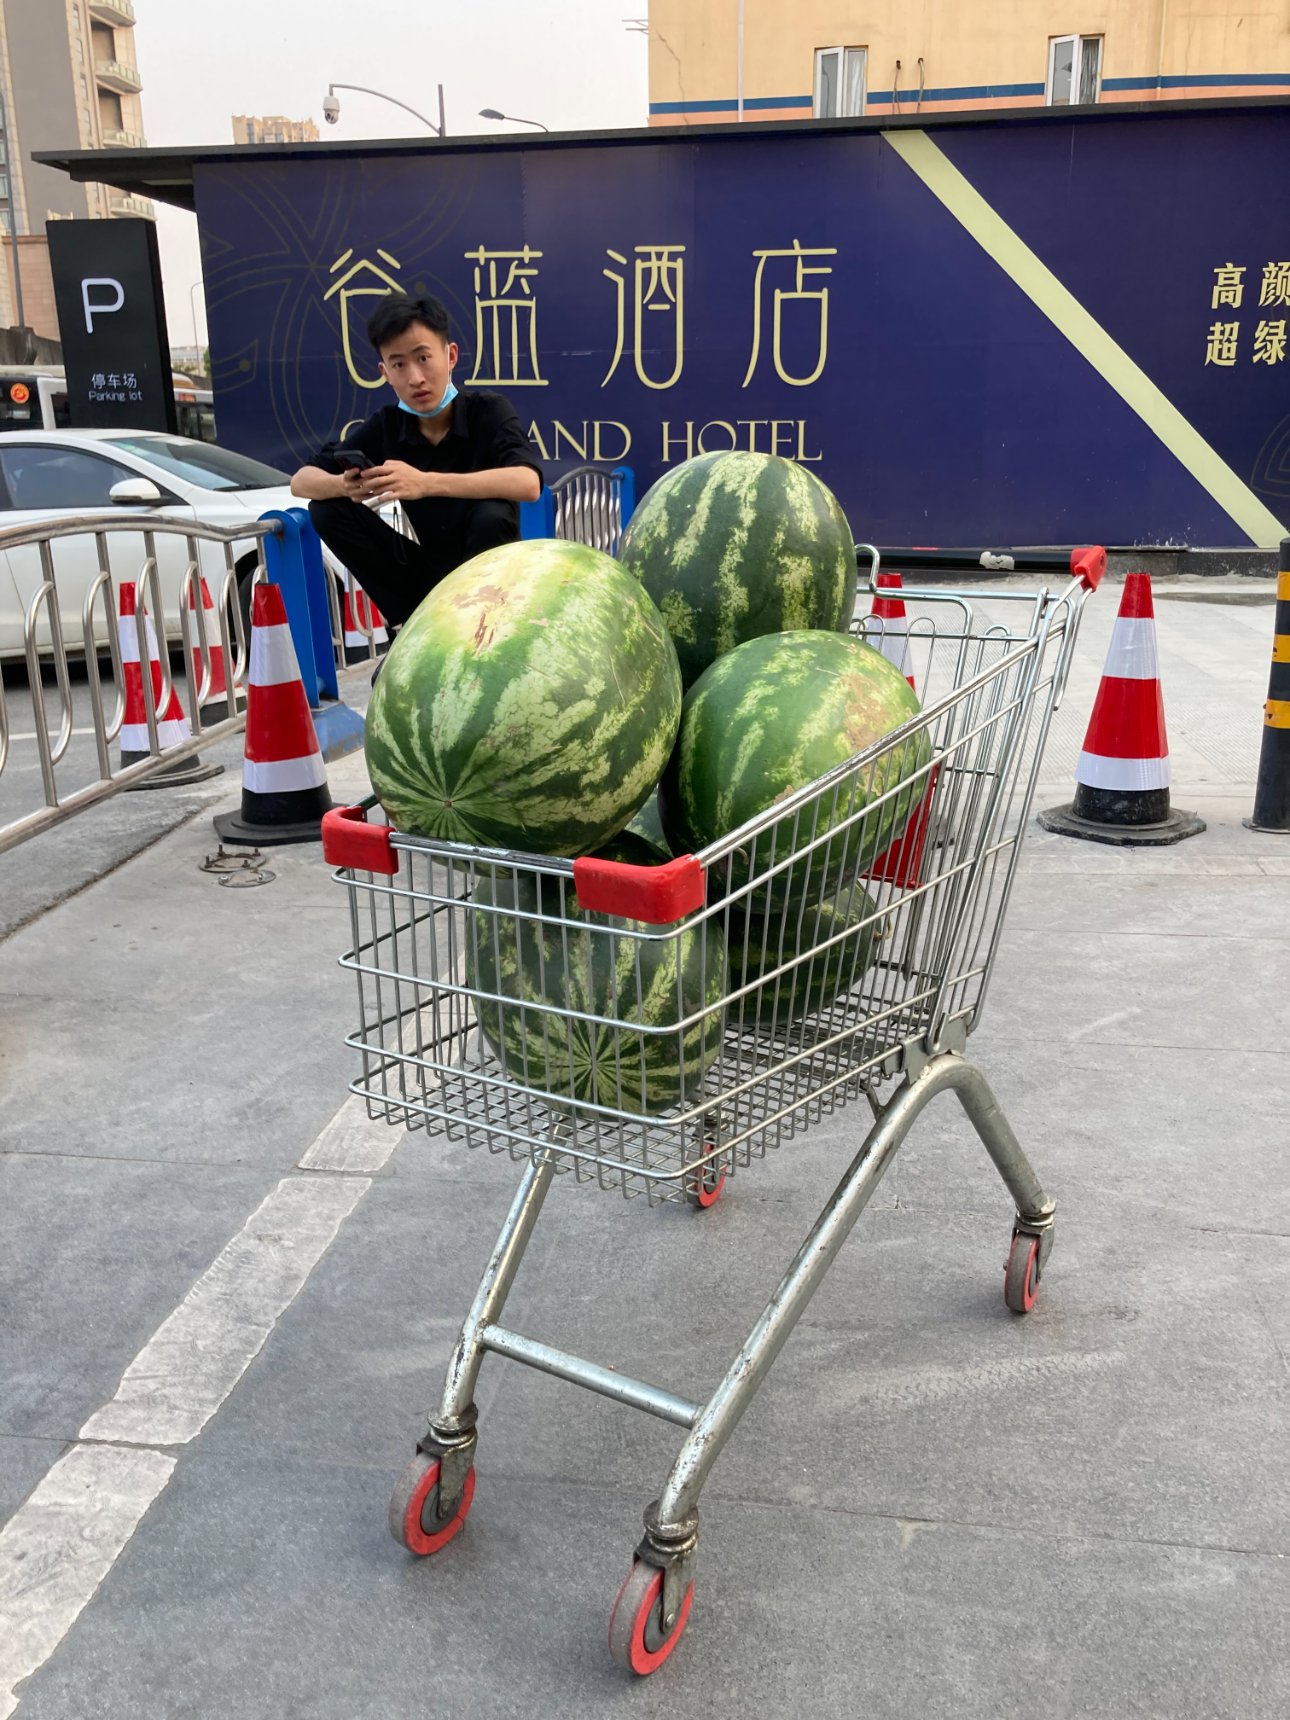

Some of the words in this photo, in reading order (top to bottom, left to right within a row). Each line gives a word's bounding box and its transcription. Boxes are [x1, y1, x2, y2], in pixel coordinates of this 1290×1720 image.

[81, 278, 125, 334] P
[1211, 262, 1290, 309] 高颜
[1204, 319, 1288, 366] 超绿
[88, 390, 126, 402] Parking
[91, 372, 137, 390] 停车场
[661, 419, 823, 462] HOTEL
